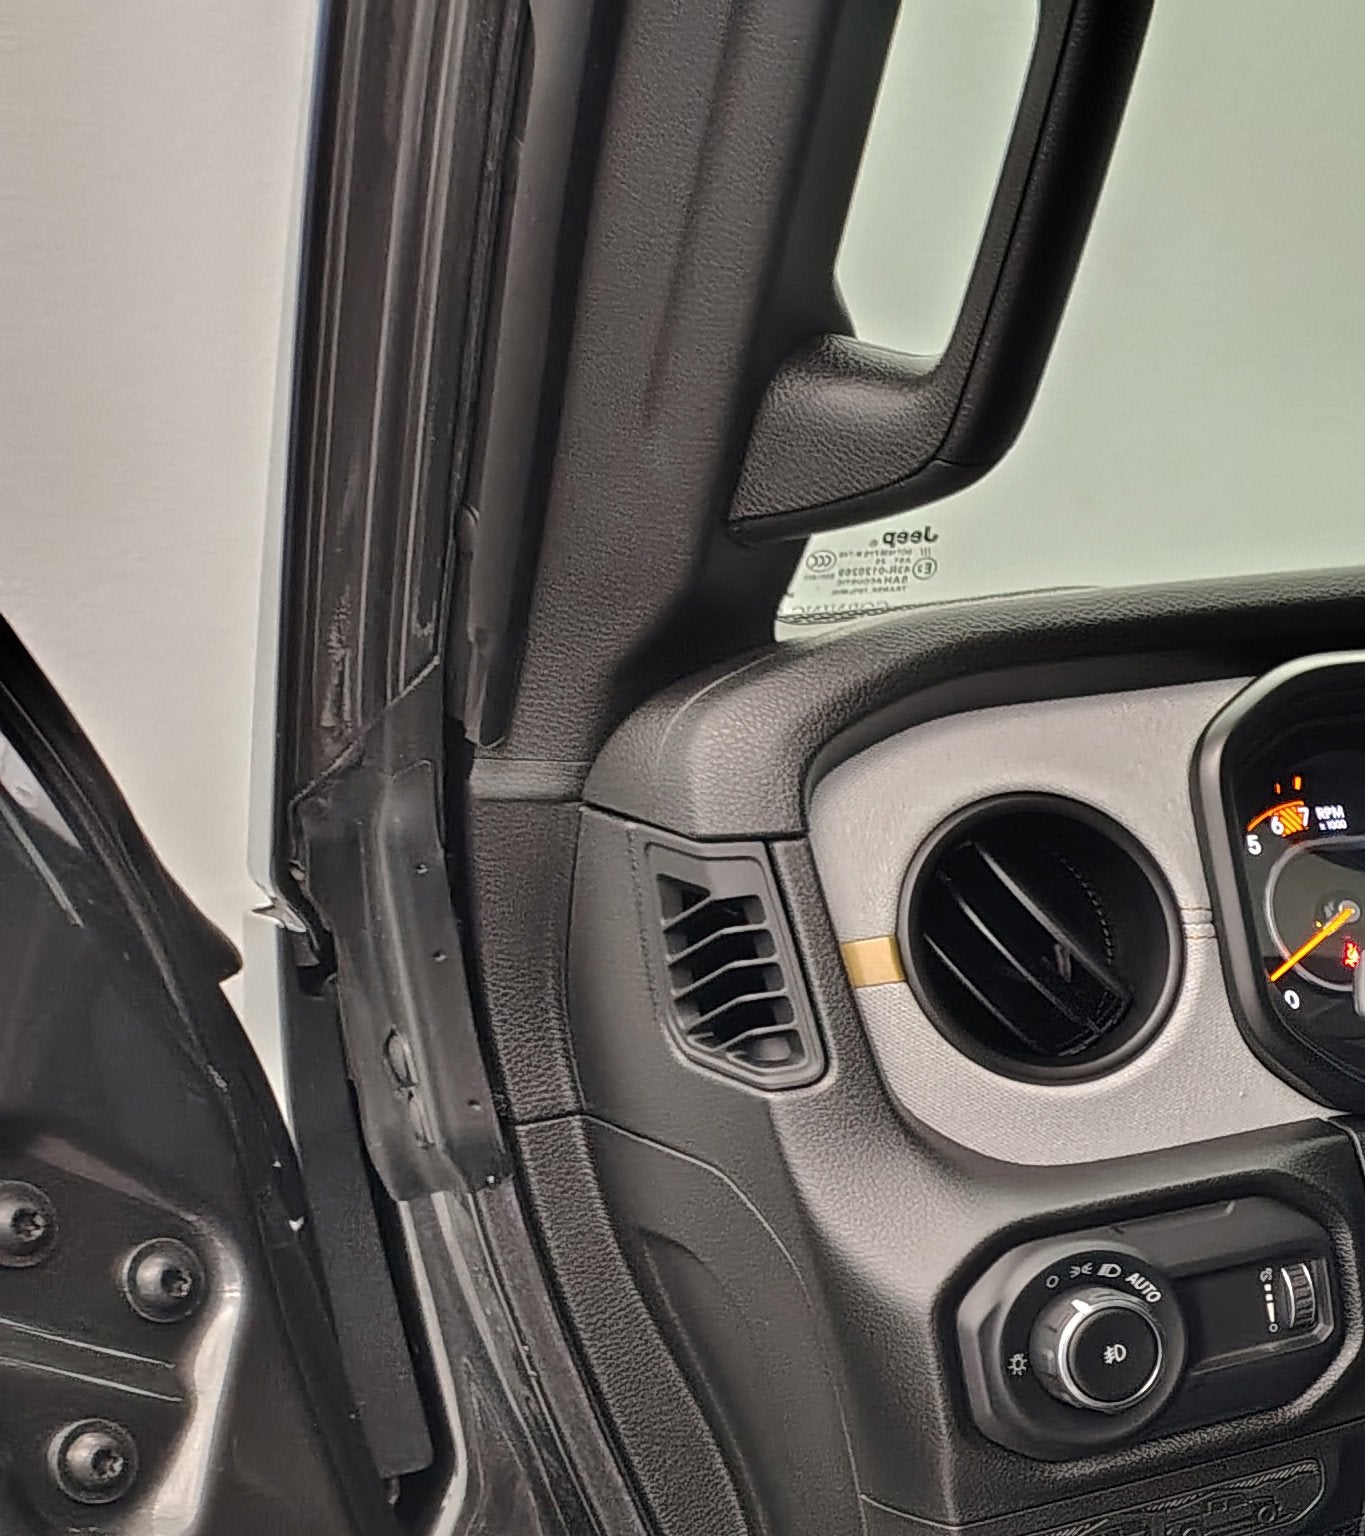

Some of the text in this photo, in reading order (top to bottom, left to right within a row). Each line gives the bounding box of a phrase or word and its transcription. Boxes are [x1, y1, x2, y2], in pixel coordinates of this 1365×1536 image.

[1297, 806, 1310, 827] 7
[1315, 804, 1345, 821] RPM
[1270, 816, 1284, 836] 6
[1246, 834, 1262, 856] 5
[1283, 987, 1301, 1011] 0
[1124, 1271, 1163, 1305] AUTO
